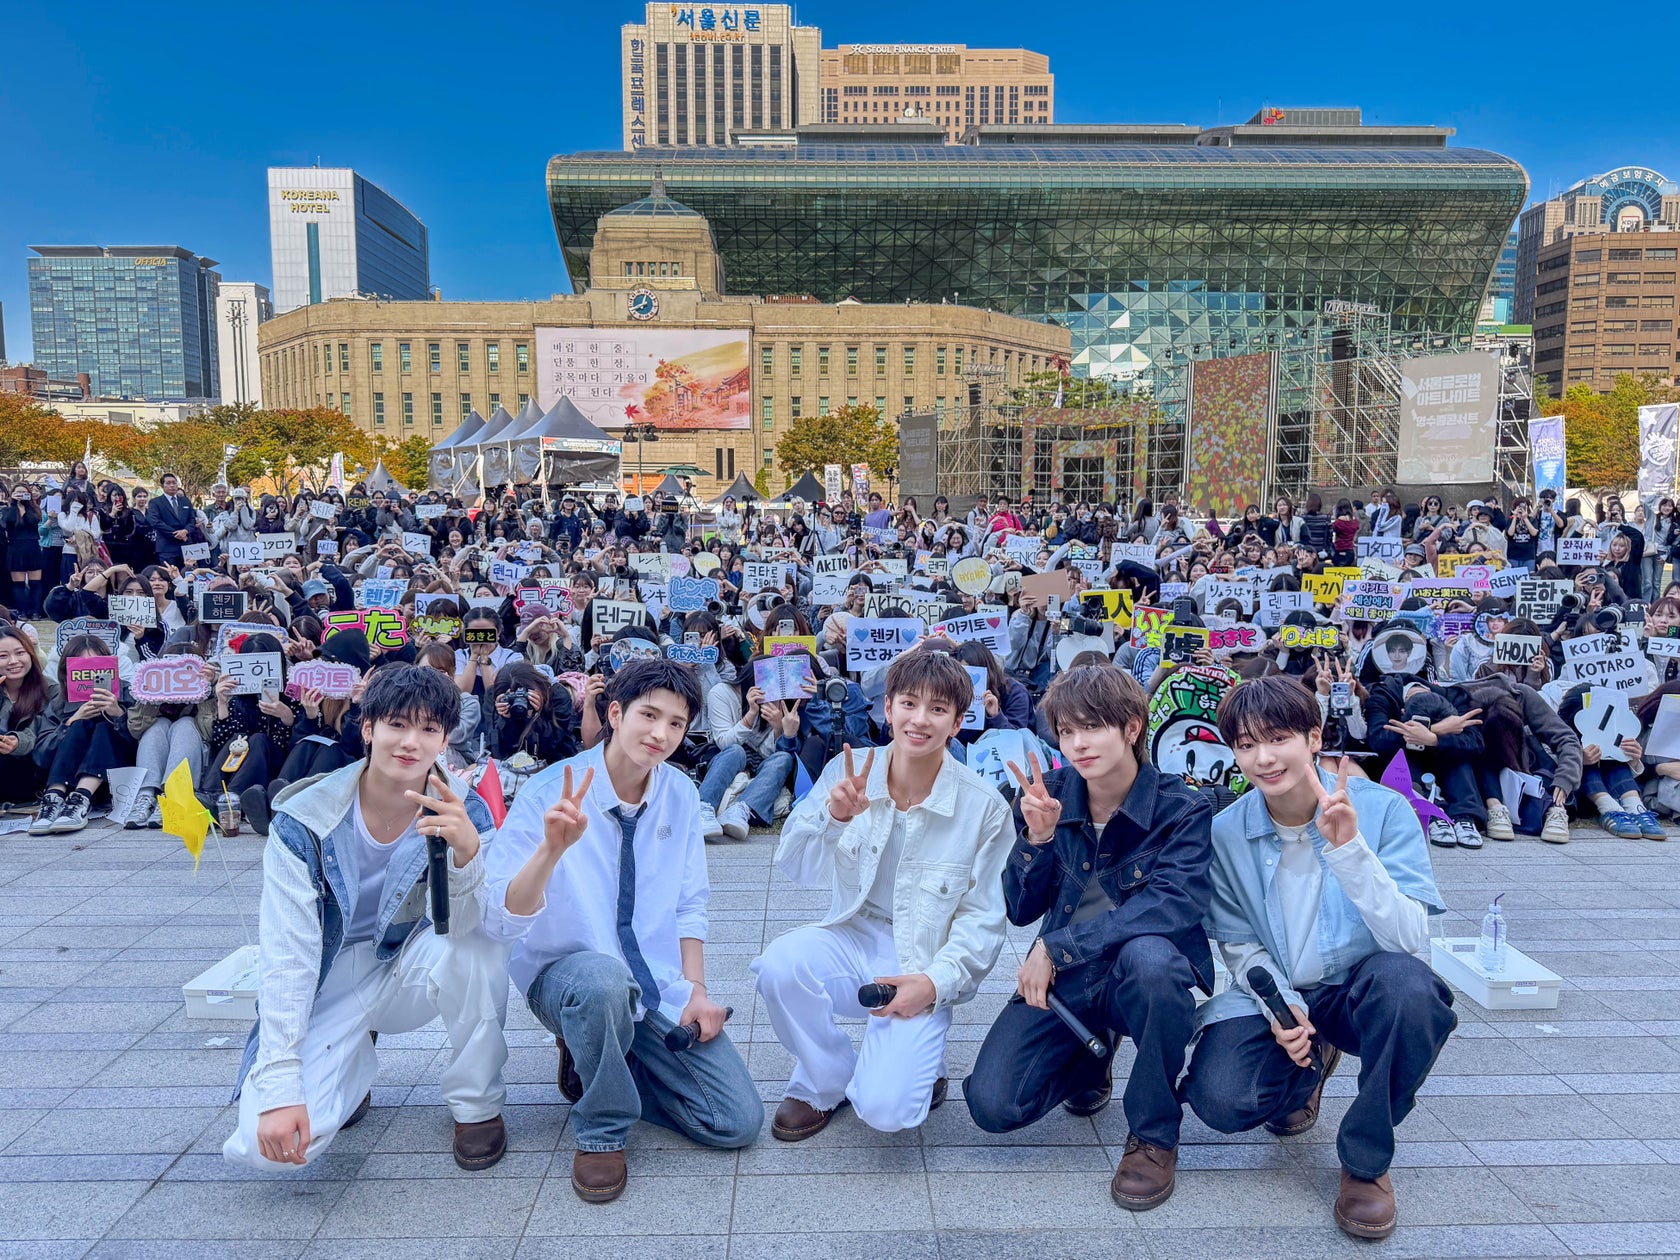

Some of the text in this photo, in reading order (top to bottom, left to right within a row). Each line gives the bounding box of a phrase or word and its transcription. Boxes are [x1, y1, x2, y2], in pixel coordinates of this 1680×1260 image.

[866, 45, 891, 54] SEOUL
[894, 45, 926, 54] FINANCE
[928, 45, 956, 54] CENTER
[281, 189, 339, 200] KOREANA
[290, 202, 330, 214] HOTEL
[552, 341, 575, 353] 바람
[589, 341, 599, 353] 한
[553, 357, 576, 368] 단풍
[590, 357, 599, 368] 한
[553, 371, 648, 383] 골목마다 가을이
[590, 385, 613, 397] 된다
[232, 546, 263, 561] 이오
[816, 557, 848, 573] AKITO
[747, 566, 779, 579] 코타로
[671, 577, 718, 597] レンキ
[212, 594, 234, 606] 렌키
[212, 607, 235, 618] 하트
[947, 619, 988, 635] 아키토
[466, 631, 495, 641] あきと
[870, 628, 900, 643] 렌키
[1574, 657, 1635, 680] KOTARO
[144, 667, 198, 694] 이오
[299, 671, 349, 689] 아키토
[1616, 678, 1634, 690] me
